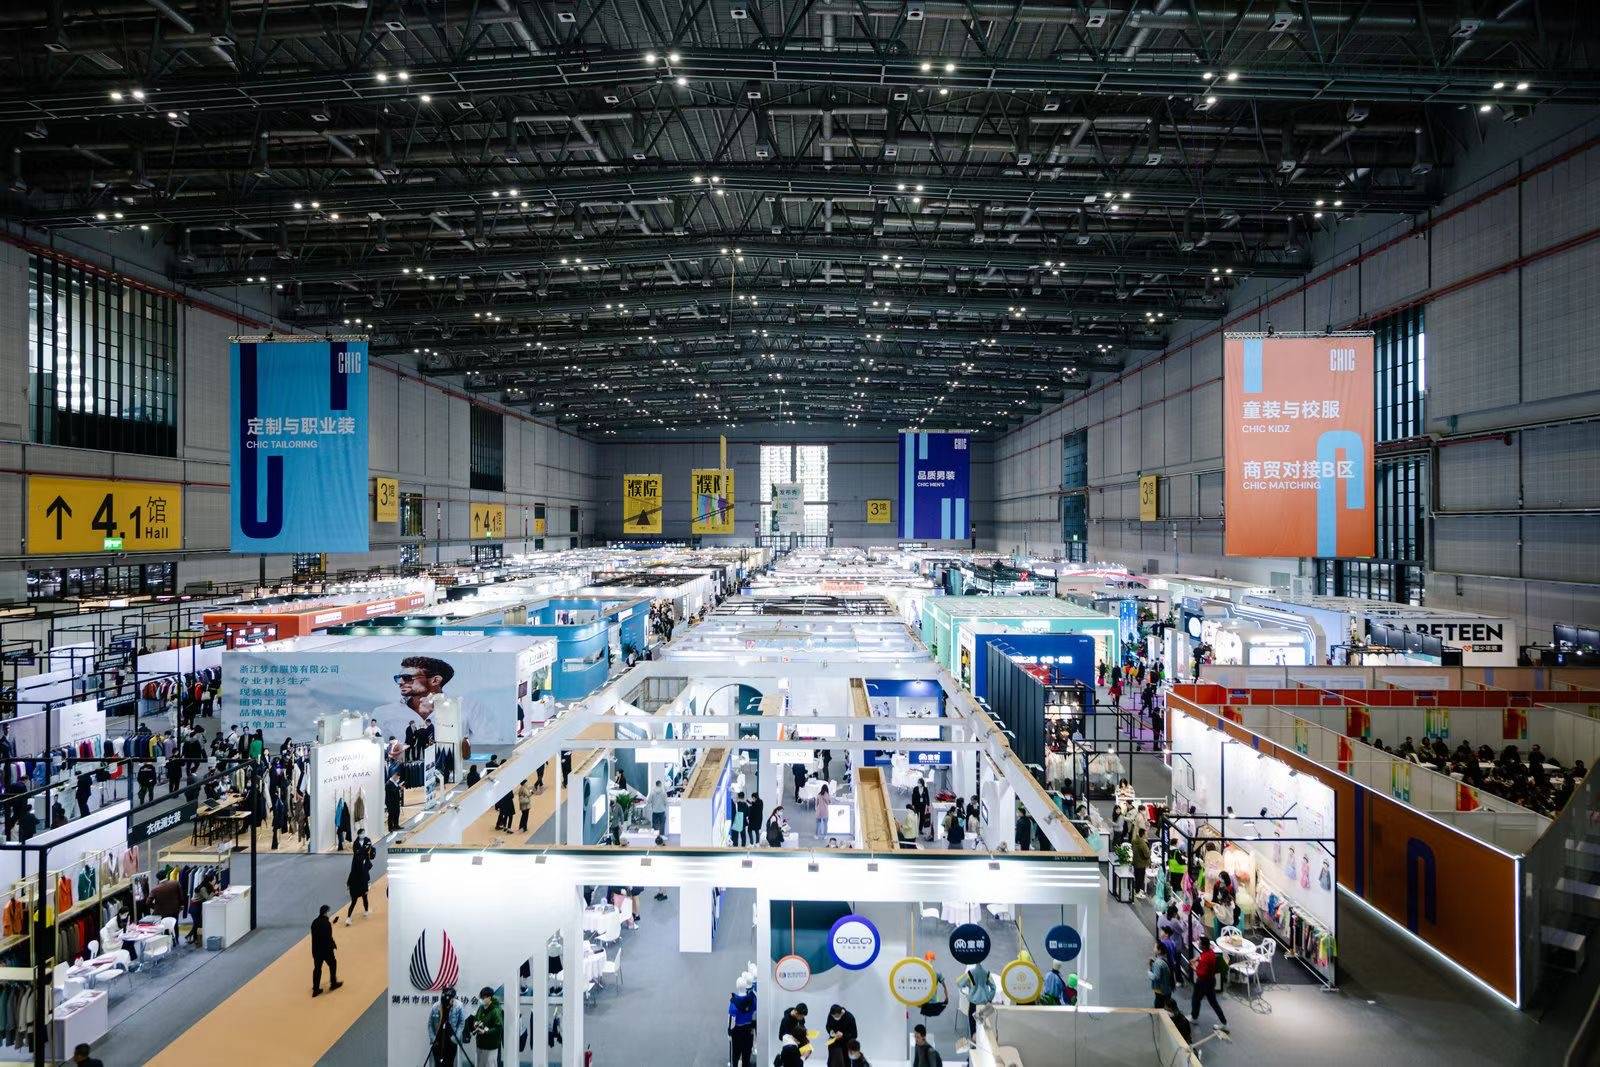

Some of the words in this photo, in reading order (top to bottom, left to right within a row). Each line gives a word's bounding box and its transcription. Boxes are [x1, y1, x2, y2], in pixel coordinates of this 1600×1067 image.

[338, 352, 361, 374] CHIC
[1329, 348, 1356, 372] CHIC
[1242, 400, 1341, 419] 童装与校服
[247, 416, 356, 435] 定制与职业装
[1242, 424, 1266, 433] CHIC
[1268, 424, 1291, 433] KIDZ
[246, 440, 269, 449] CHIC
[270, 440, 318, 449] TAILORING
[917, 470, 956, 480] 品质男装
[1243, 460, 1355, 479] 商贸对接B区
[627, 479, 658, 497] 濮院
[1242, 481, 1267, 490] CHIC
[1269, 481, 1322, 490] MATCHING
[871, 502, 879, 515] 3
[91, 493, 142, 539] 4.1
[146, 496, 167, 524] 馆
[145, 527, 169, 539] Hall
[239, 664, 339, 674] 浙江梦森服饰有限公司
[240, 676, 309, 687] 专业衬衫生产
[240, 688, 287, 697] 现货供应
[240, 698, 287, 707] 团购工服
[240, 709, 287, 717] 品牌贴牌
[240, 720, 287, 729] 订单加工
[323, 771, 371, 784] KASHIYAMA
[392, 995, 479, 1006] 湖州市织里协会
